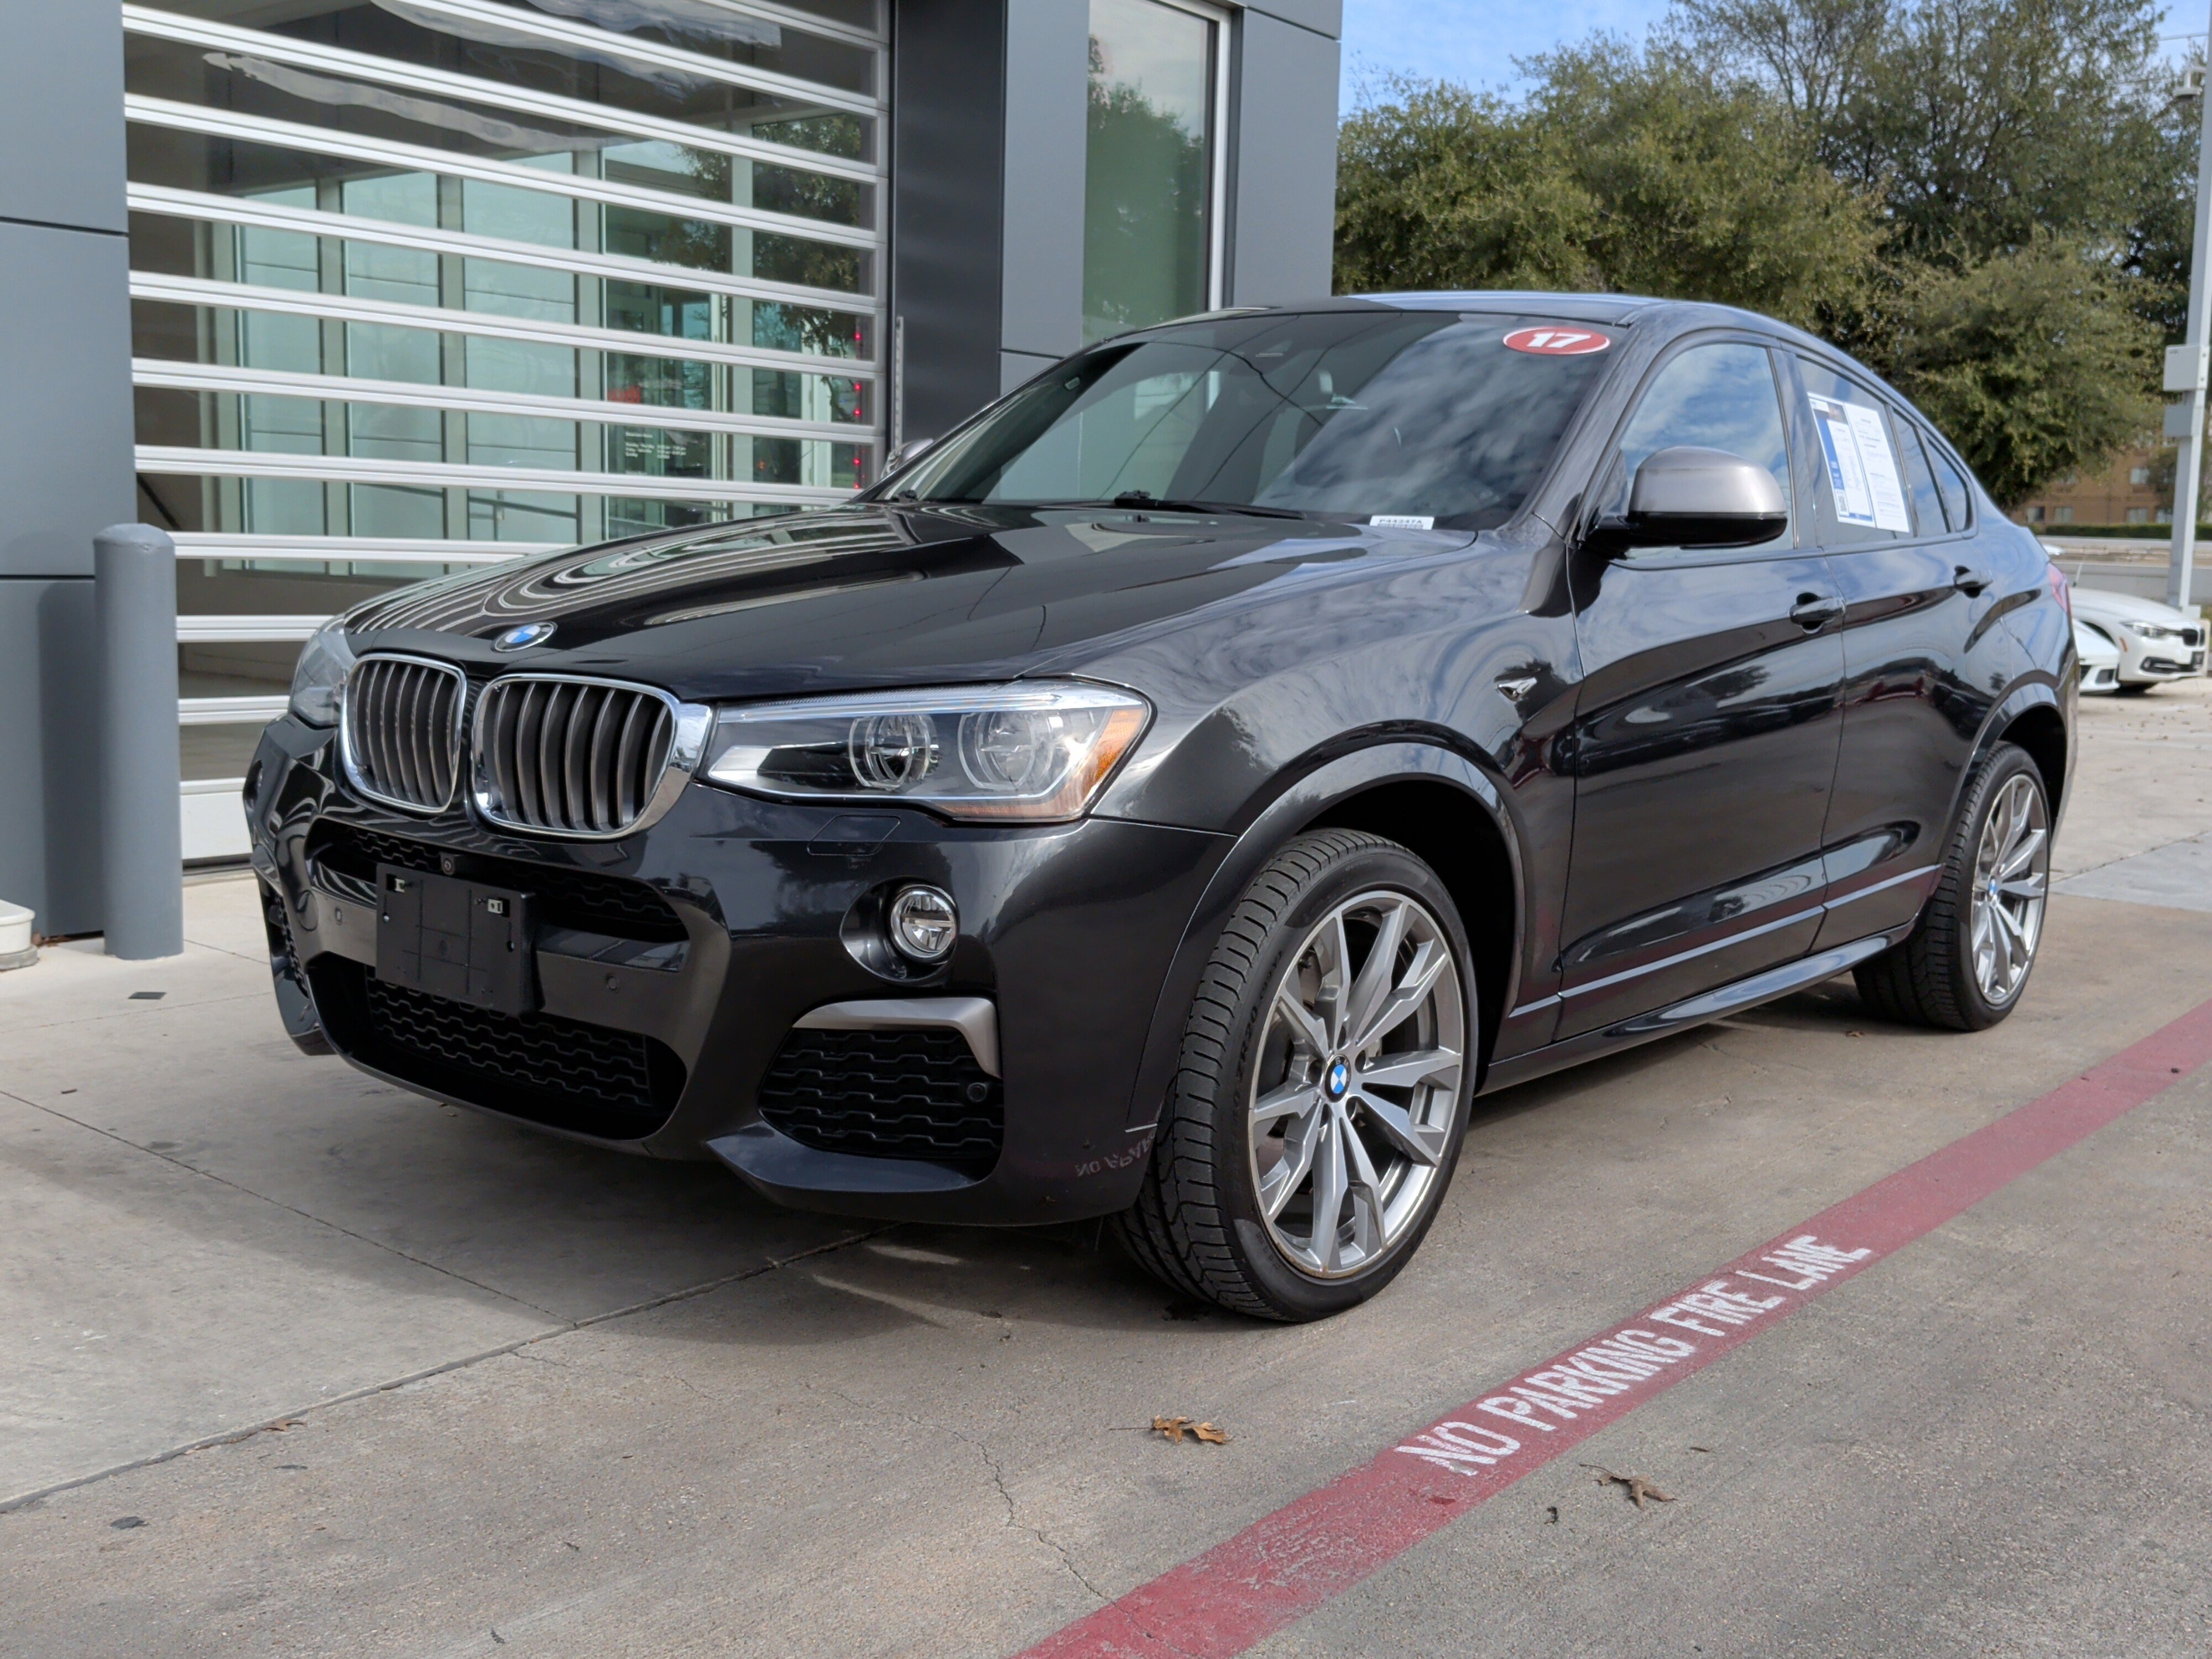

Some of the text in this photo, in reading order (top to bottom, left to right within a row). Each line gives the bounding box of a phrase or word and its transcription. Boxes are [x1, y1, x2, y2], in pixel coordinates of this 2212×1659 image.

[1527, 332, 1592, 348] 17
[1394, 1234, 1871, 1477] NO PARKING FIRE LANE
